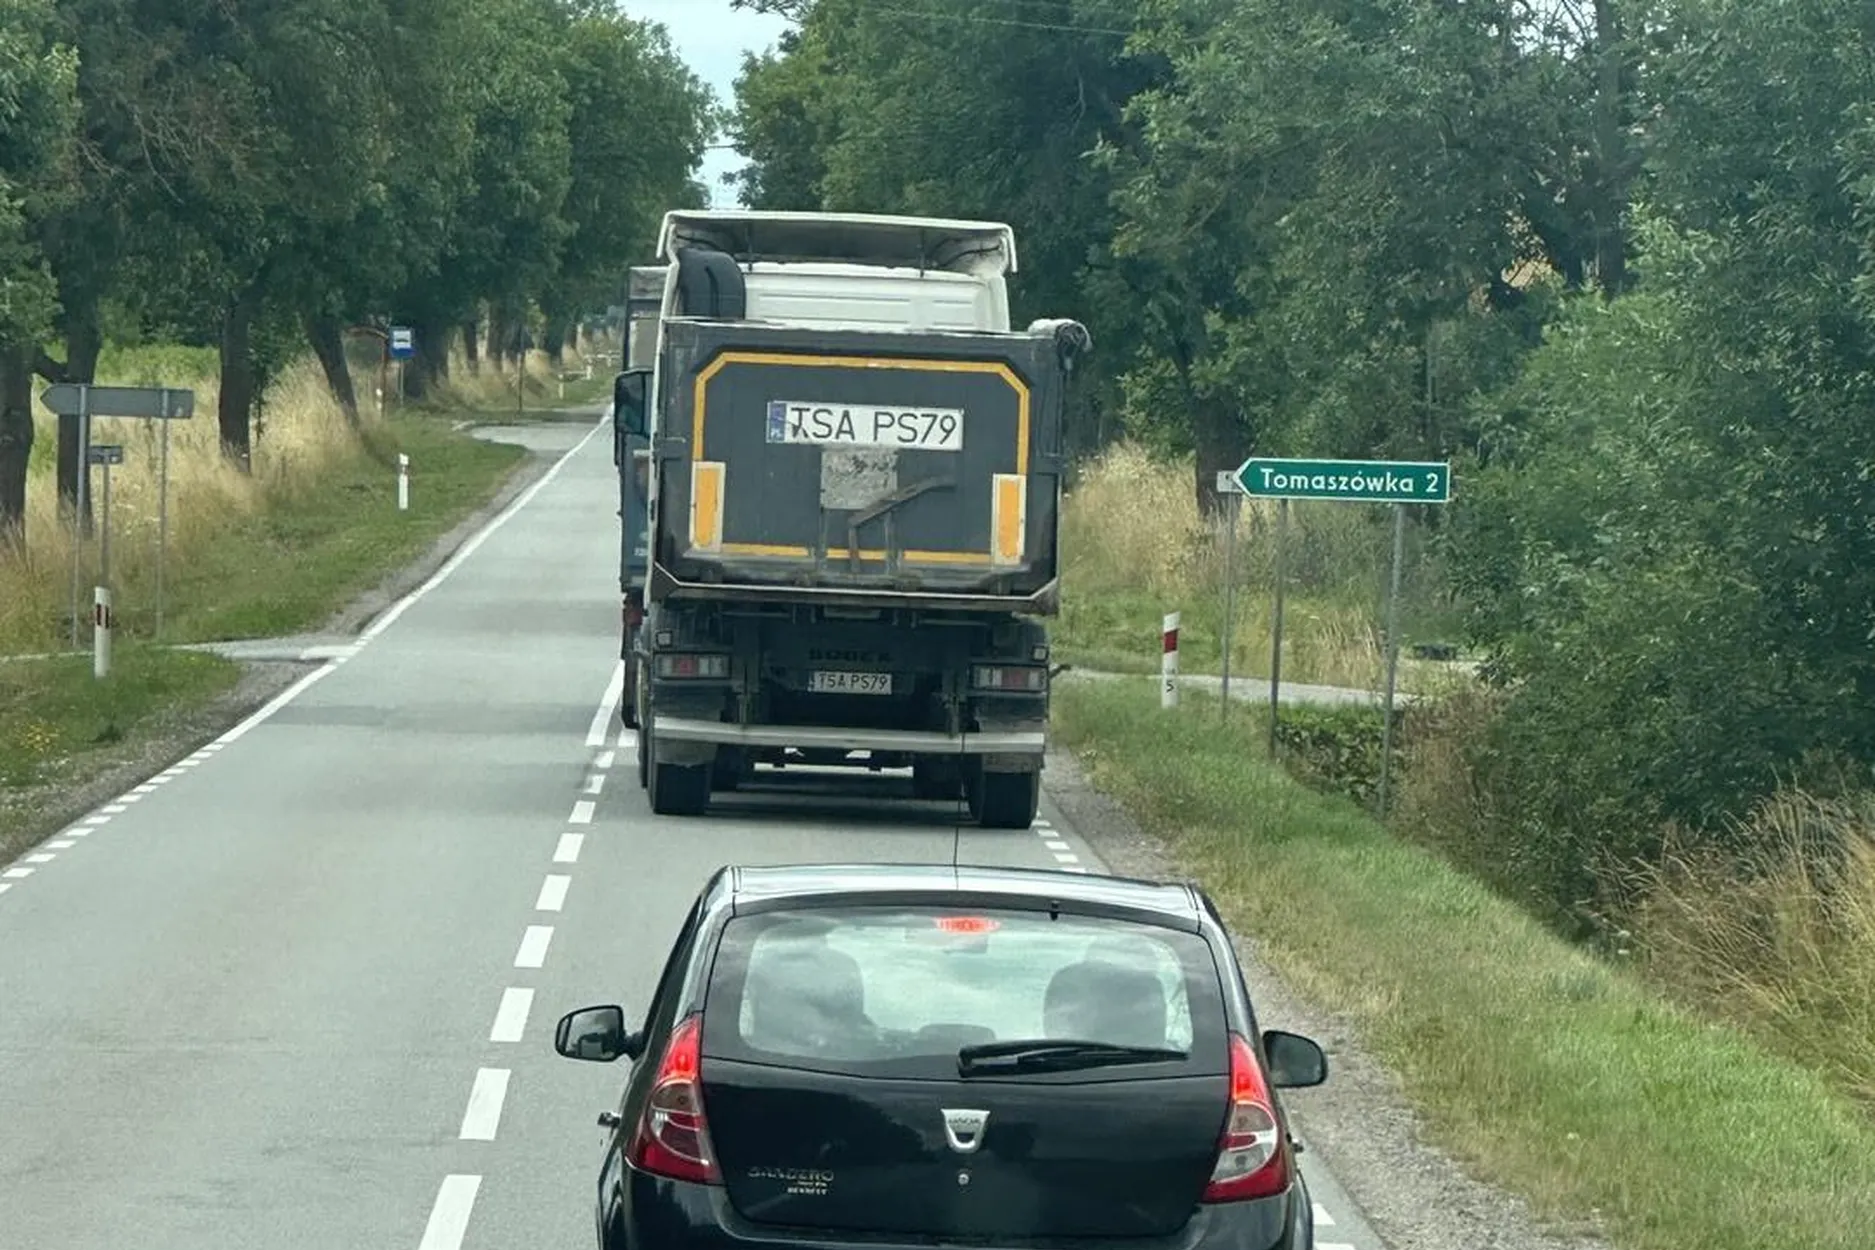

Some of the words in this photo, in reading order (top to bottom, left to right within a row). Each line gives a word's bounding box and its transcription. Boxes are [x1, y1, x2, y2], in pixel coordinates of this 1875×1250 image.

[791, 407, 855, 440] TSA
[873, 411, 957, 445] PS79
[1260, 467, 1414, 493] Tomaszówka
[1425, 473, 1439, 493] 2
[819, 673, 846, 688] TSA
[851, 674, 888, 690] PS79
